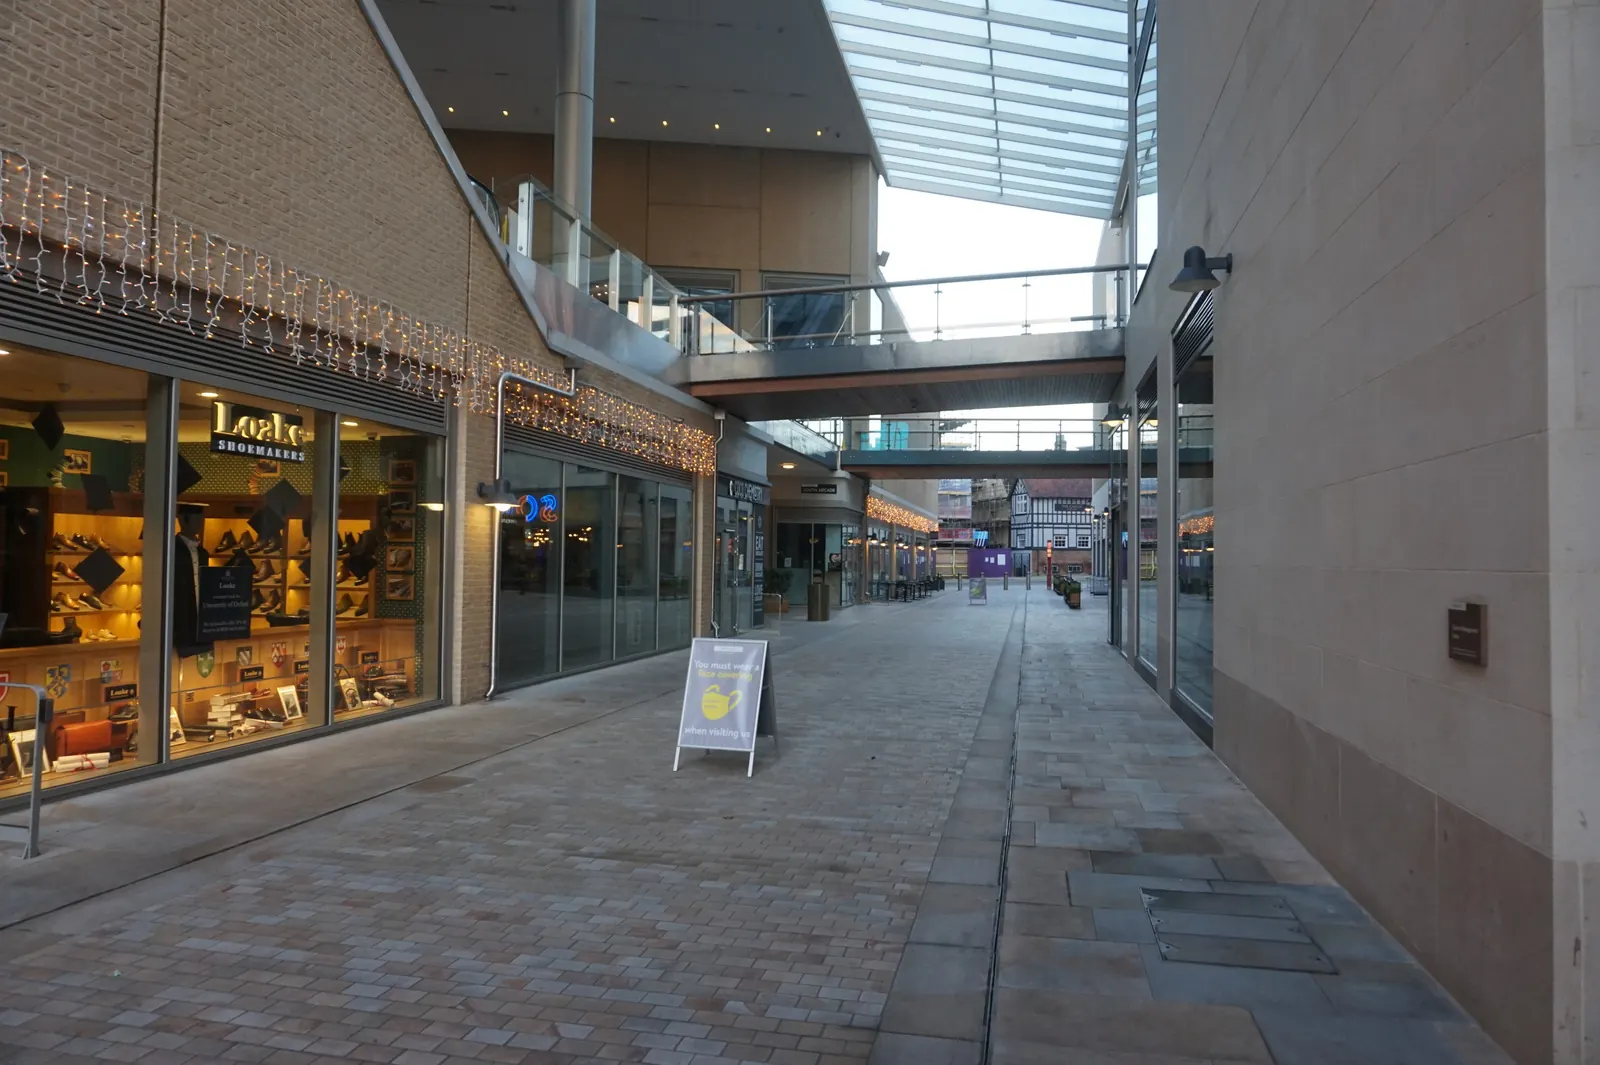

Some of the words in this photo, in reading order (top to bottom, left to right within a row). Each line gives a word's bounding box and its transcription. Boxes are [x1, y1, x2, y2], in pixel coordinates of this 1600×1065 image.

[213, 402, 305, 446] Loake
[218, 440, 305, 461] SHOEMAKERS
[695, 660, 708, 669] You
[710, 661, 731, 670] must
[684, 725, 707, 736] when
[708, 727, 739, 740] visiting
